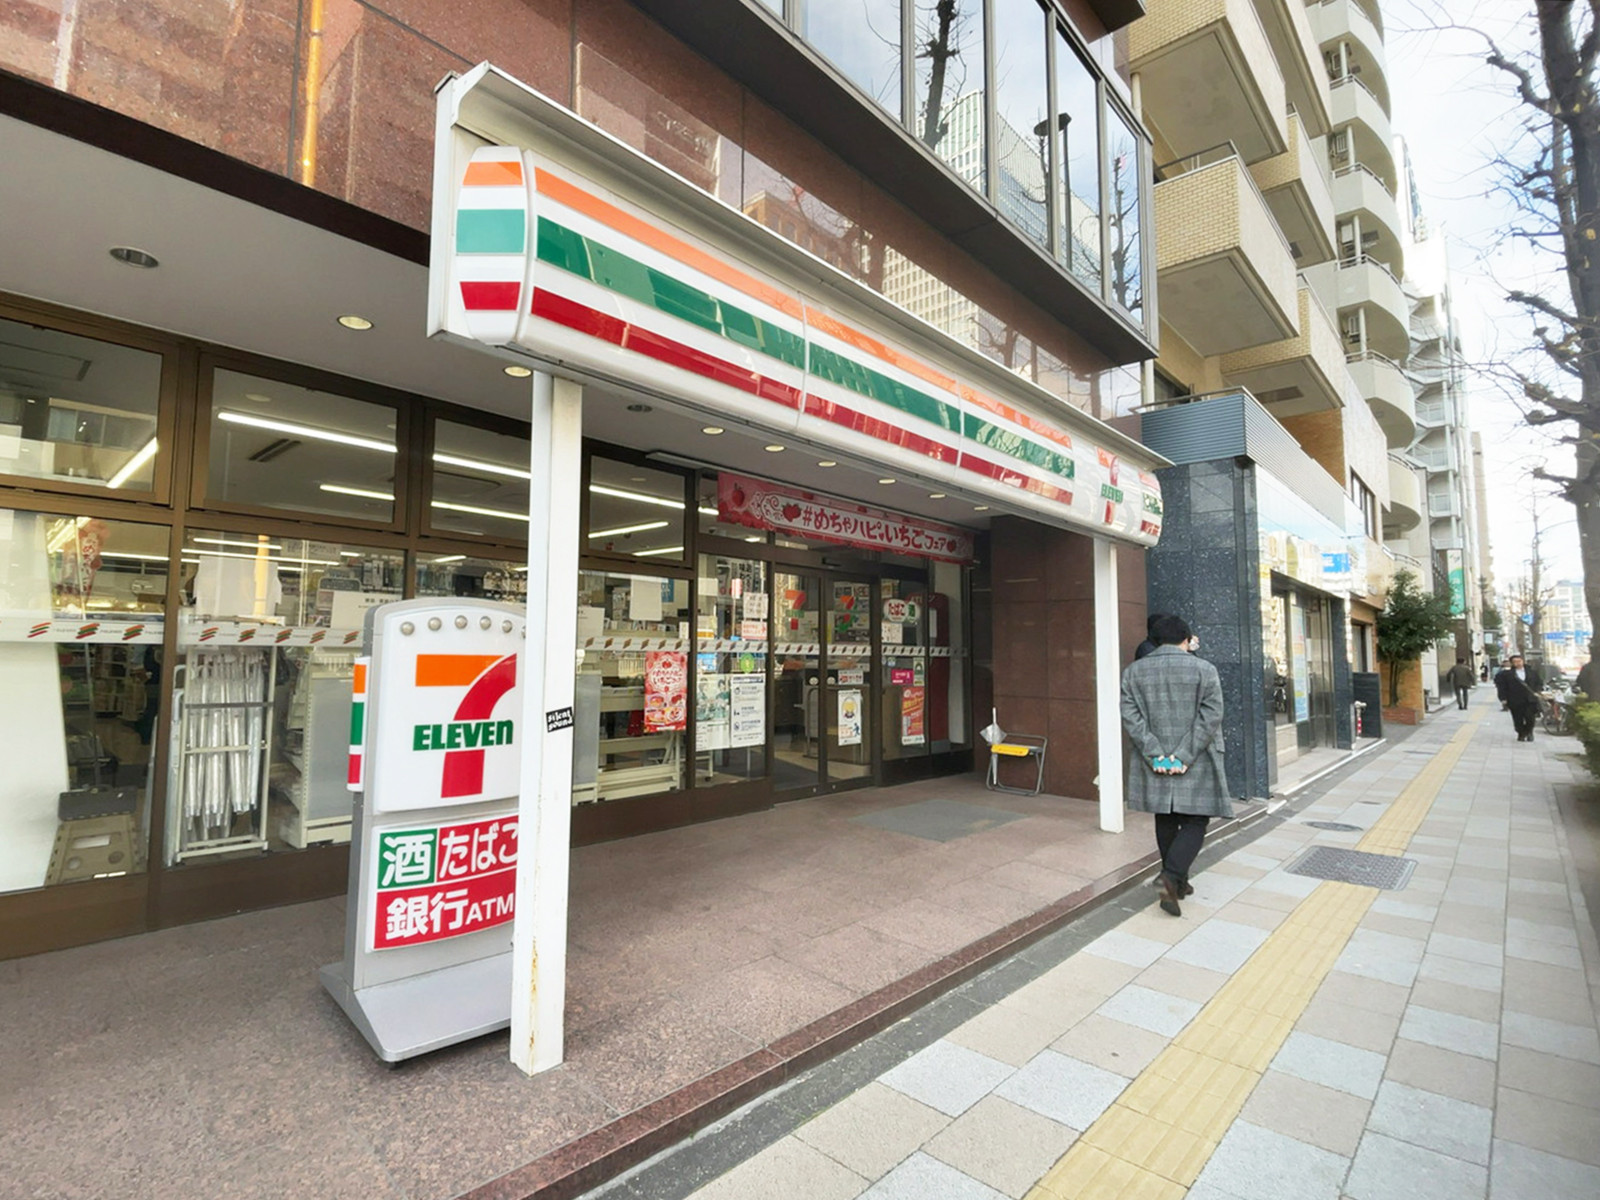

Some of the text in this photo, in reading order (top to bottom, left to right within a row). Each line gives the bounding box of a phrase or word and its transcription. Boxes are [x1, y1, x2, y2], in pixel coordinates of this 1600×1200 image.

[381, 821, 519, 887] 酒 たばこ
